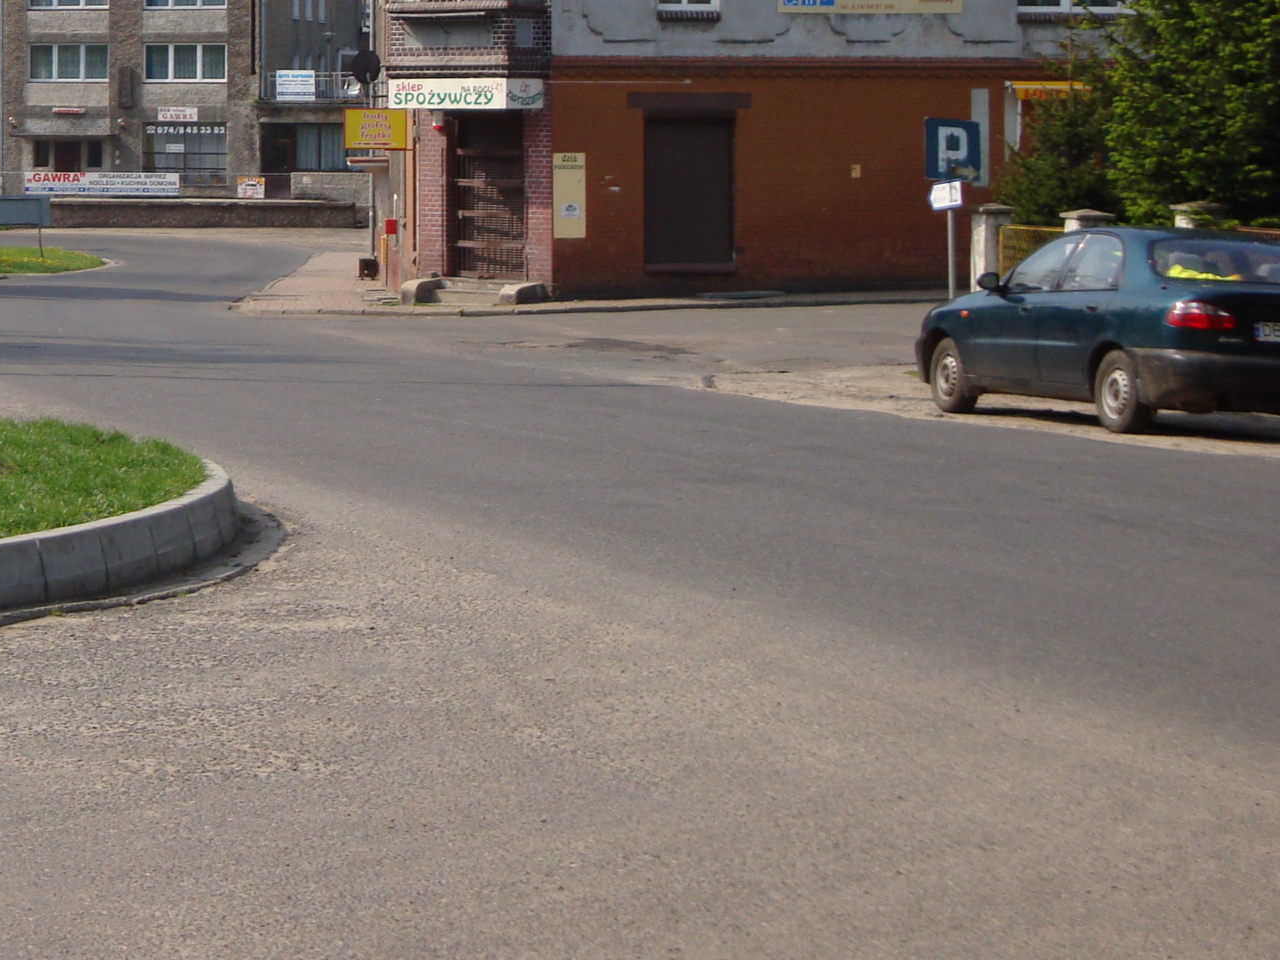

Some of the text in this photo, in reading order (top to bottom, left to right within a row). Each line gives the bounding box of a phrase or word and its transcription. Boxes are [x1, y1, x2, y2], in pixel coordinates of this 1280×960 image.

[395, 82, 424, 92] sklep
[461, 86, 471, 94] NA
[393, 89, 494, 106] SPOŻYWCZY
[363, 111, 388, 121] lody
[360, 121, 392, 131] gofry
[361, 131, 391, 141] frytki
[938, 125, 968, 173] P
